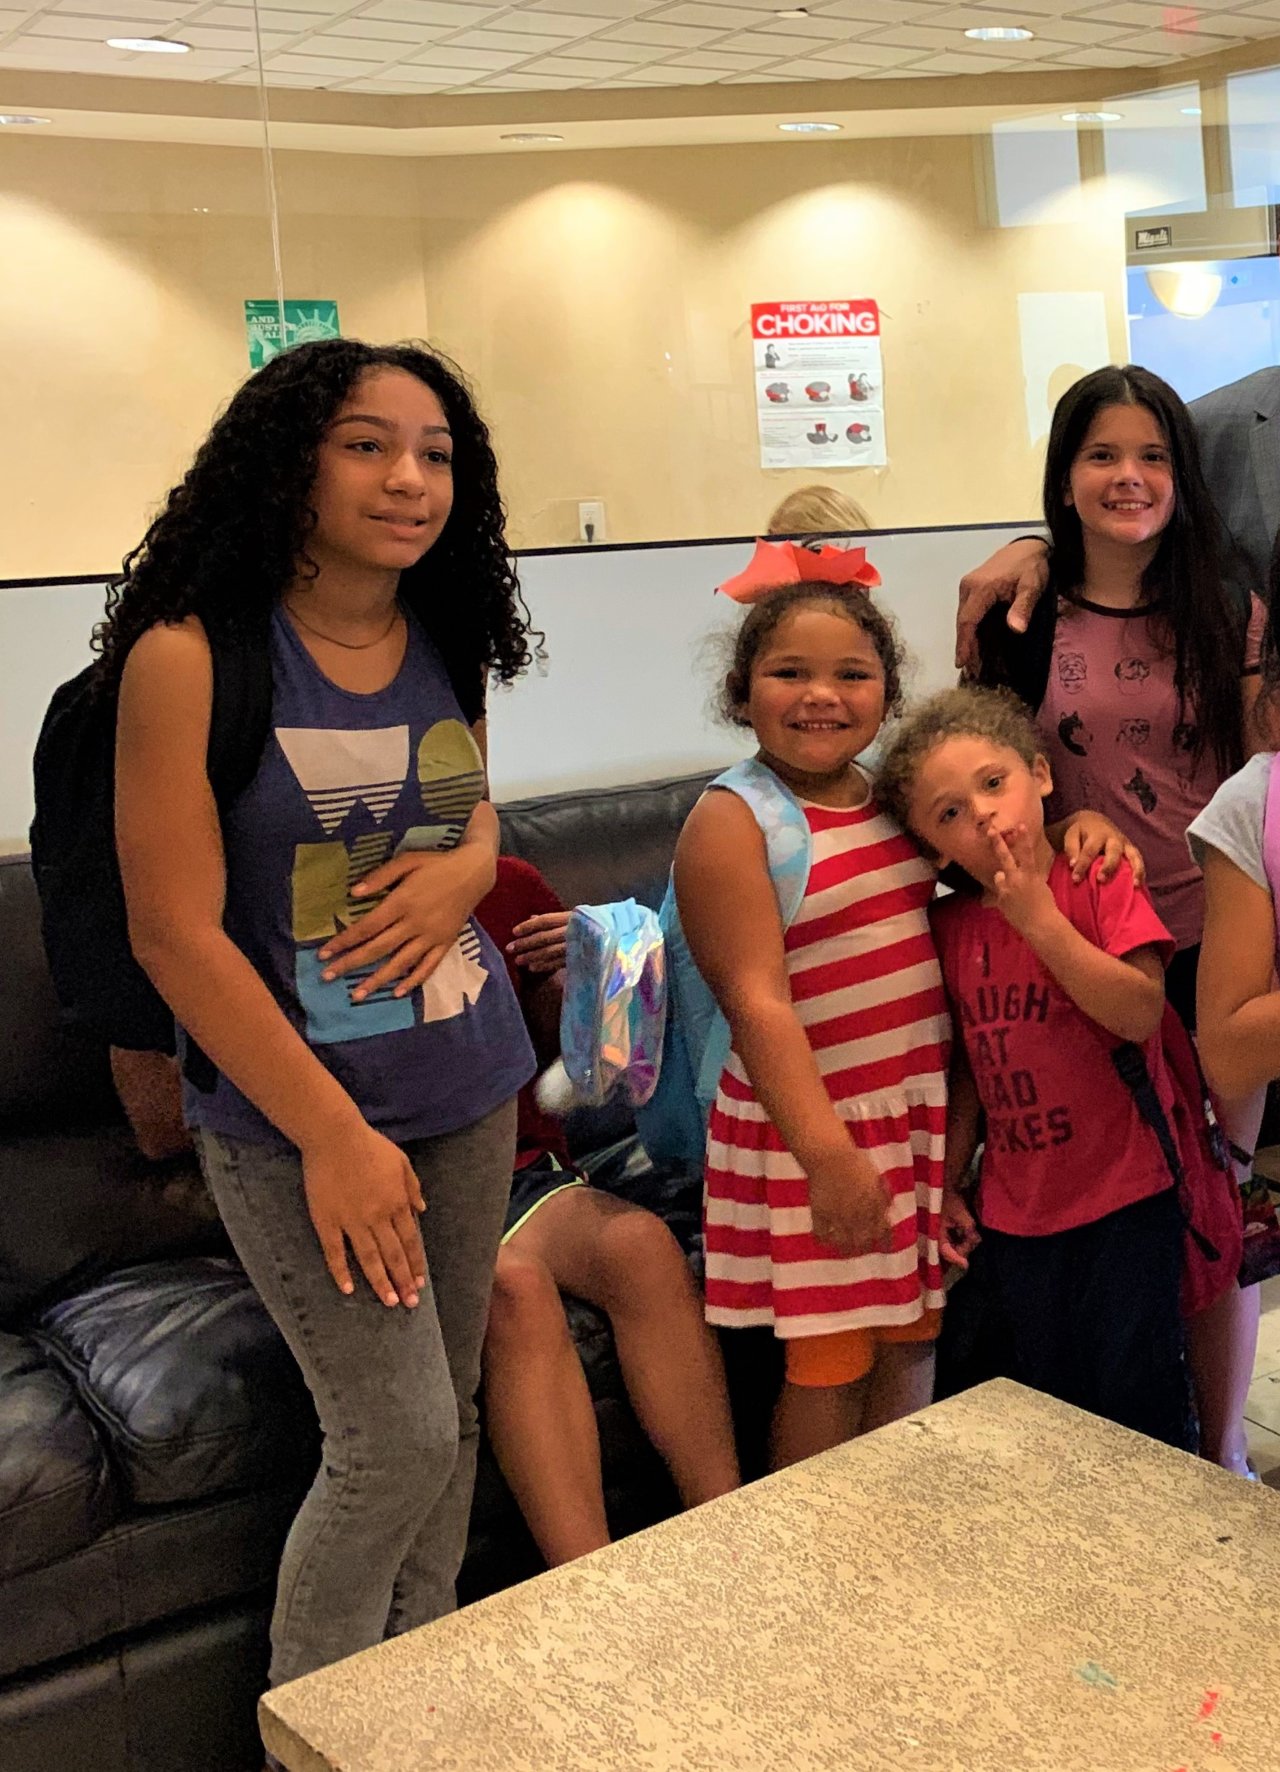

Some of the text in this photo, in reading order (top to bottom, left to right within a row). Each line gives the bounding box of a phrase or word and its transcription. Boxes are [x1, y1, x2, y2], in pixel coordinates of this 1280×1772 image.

[780, 304, 808, 313] FIRST
[829, 302, 850, 311] FOR
[251, 315, 275, 323] AND
[756, 312, 877, 336] CHOKING
[982, 942, 991, 978] I
